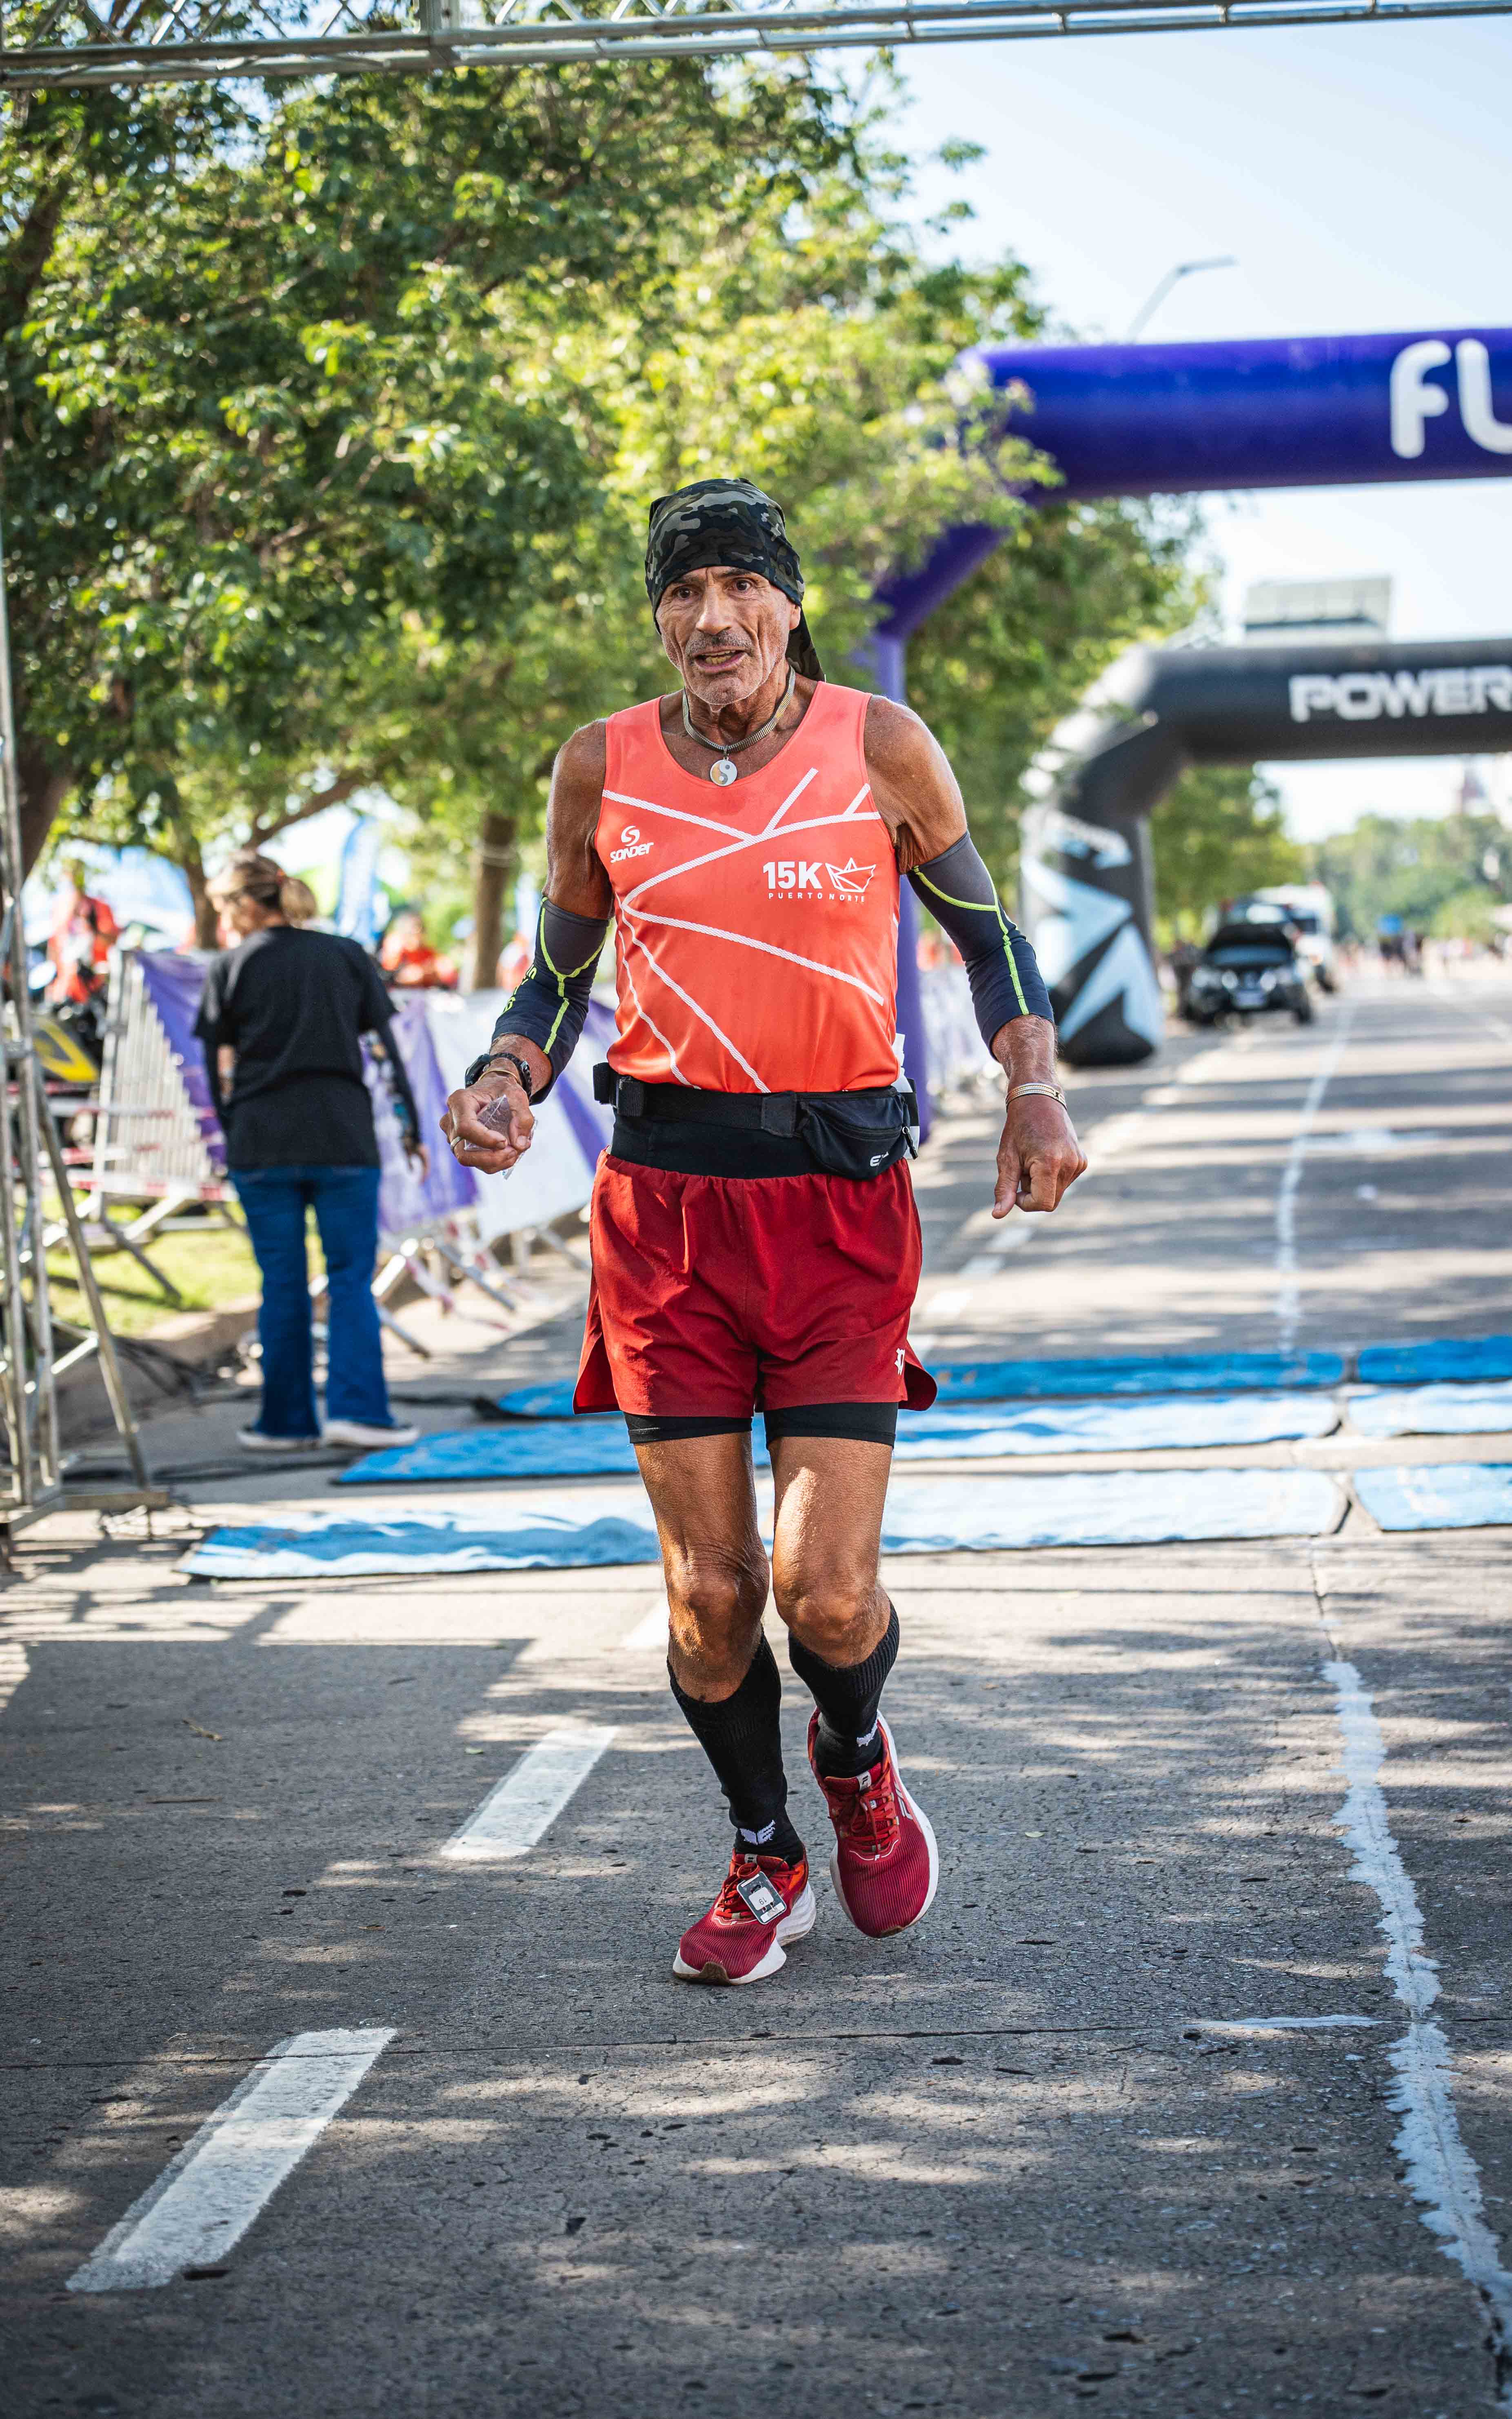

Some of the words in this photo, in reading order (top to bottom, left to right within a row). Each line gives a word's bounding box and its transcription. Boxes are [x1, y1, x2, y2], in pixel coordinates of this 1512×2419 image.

[1288, 664, 1512, 722] POWER
[763, 861, 823, 889] 15K
[829, 893, 865, 902] NORTE
